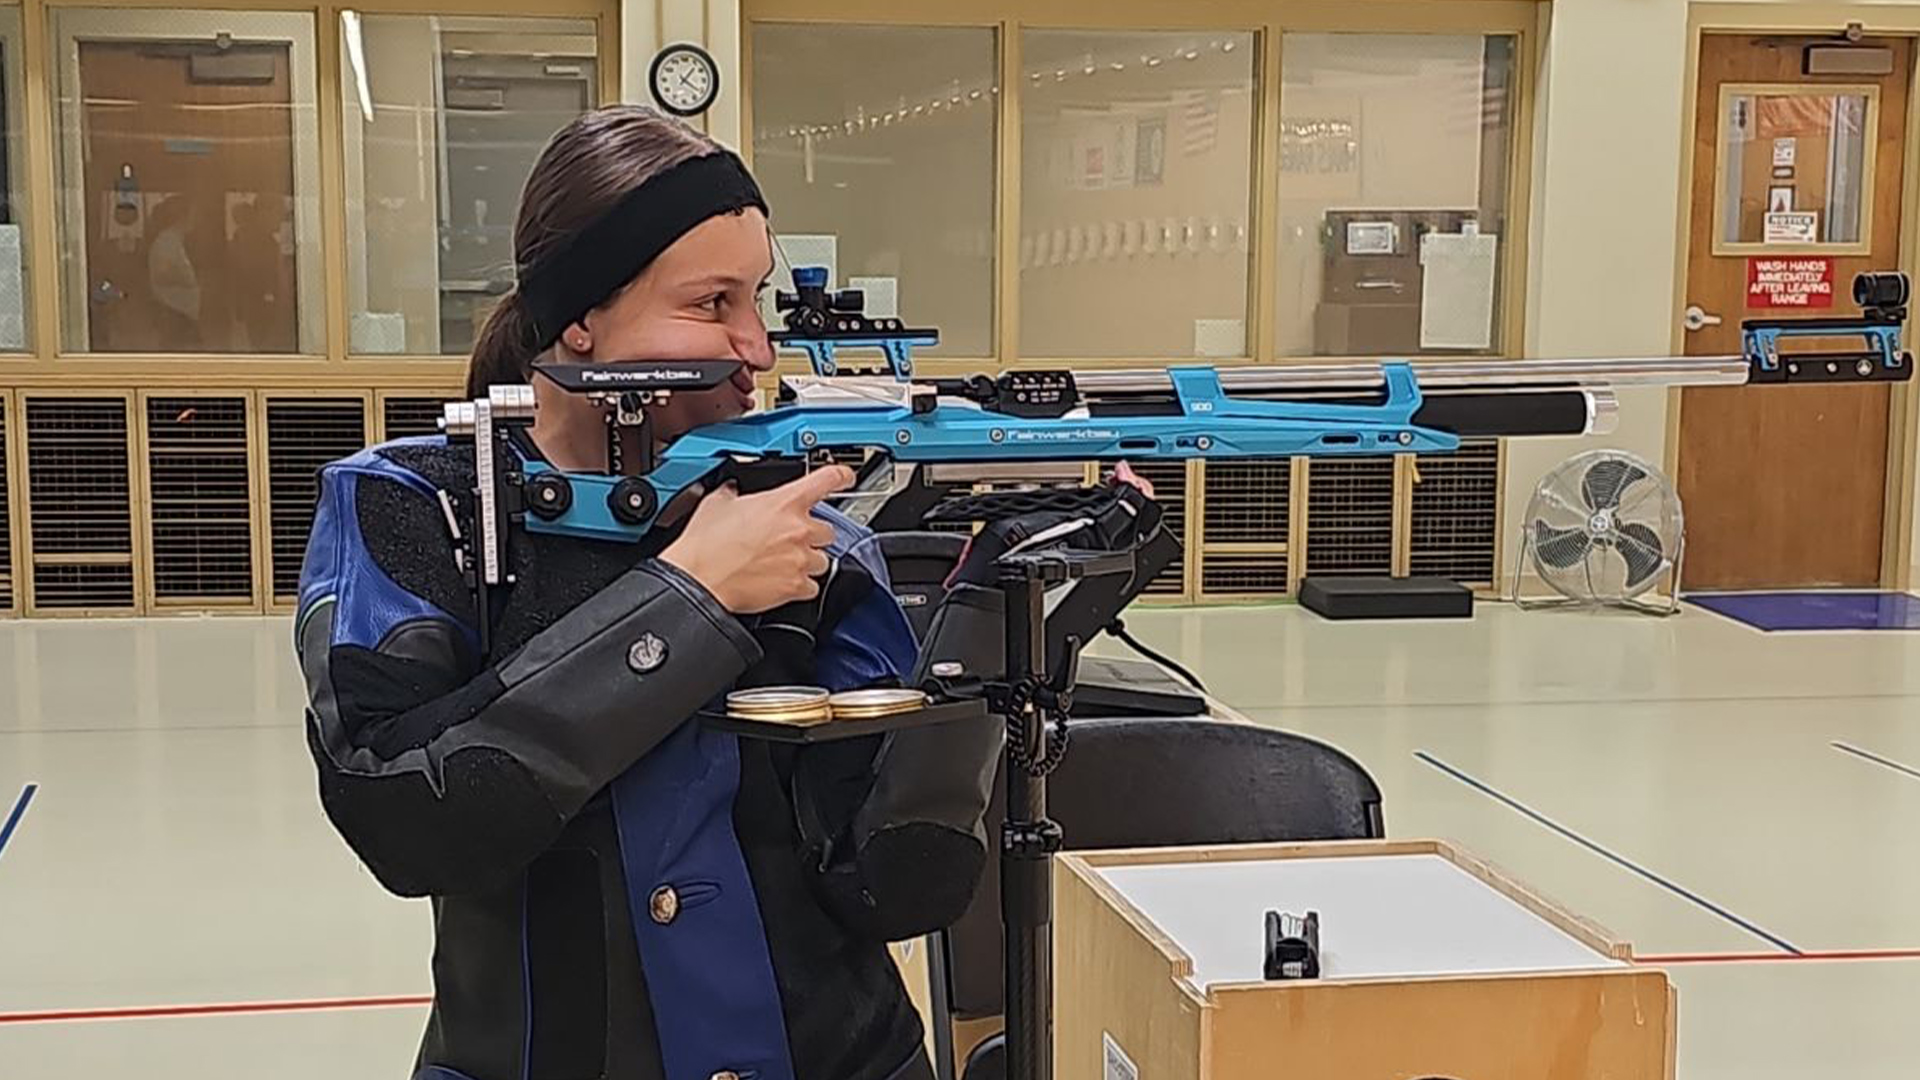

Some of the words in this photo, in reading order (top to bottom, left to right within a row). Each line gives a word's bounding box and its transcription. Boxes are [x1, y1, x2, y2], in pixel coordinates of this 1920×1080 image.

[1771, 215, 1811, 225] NOTICE
[1756, 261, 1787, 271] WASH
[1789, 261, 1826, 271] HANDS
[1757, 272, 1823, 282] IMMEDIATELY
[1750, 283, 1784, 293] AFTER
[1787, 283, 1831, 293] LEAVING
[1771, 294, 1808, 304] RANGE
[581, 370, 701, 382] Feinwerkbau
[1007, 429, 1120, 440] Feinwerkbau
